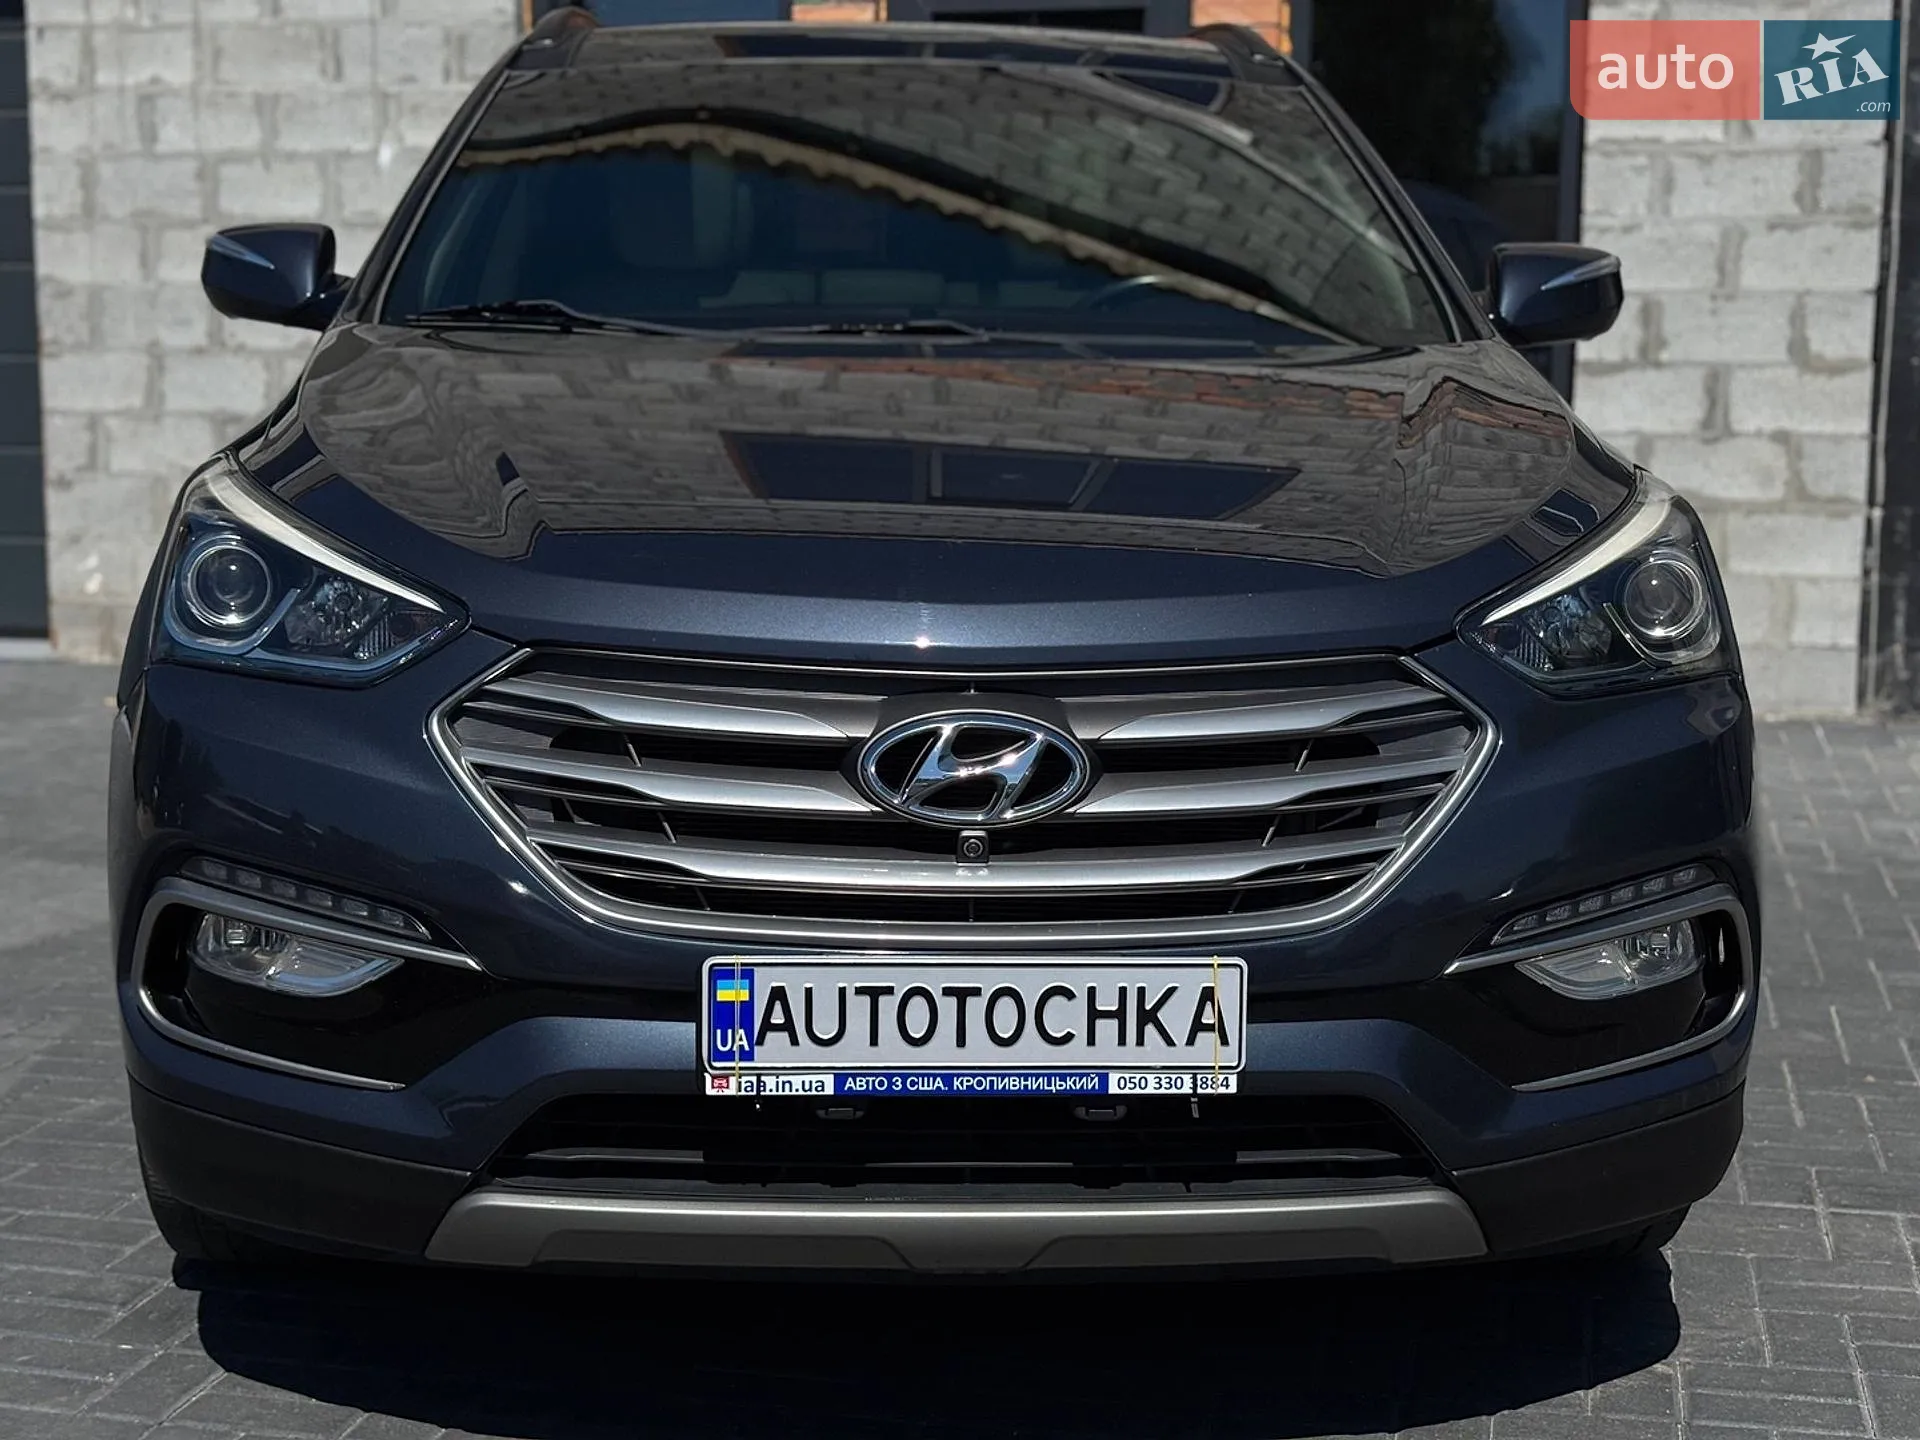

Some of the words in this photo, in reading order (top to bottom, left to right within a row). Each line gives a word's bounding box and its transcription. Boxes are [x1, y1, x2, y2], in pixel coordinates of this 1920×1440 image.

[754, 983, 1231, 1048] AUTOTOCHKA
[716, 1029, 750, 1051] UA
[844, 1076, 888, 1091] АВТО
[906, 1076, 949, 1091] США.
[953, 1074, 1099, 1093] КРОПИВНИЦЬКИЙ
[1117, 1075, 1149, 1091] 050
[1153, 1075, 1184, 1091] 330
